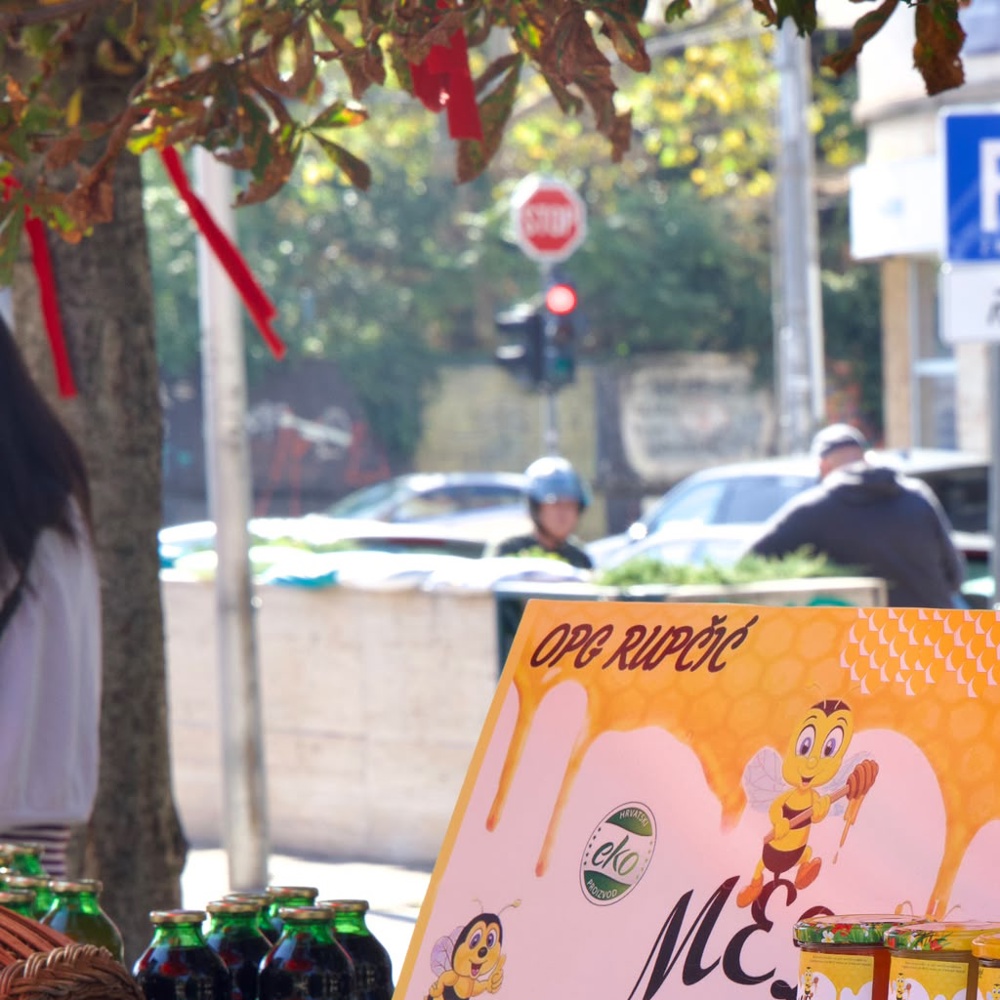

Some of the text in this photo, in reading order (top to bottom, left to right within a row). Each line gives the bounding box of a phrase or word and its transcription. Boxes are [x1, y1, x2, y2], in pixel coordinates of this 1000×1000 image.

[524, 205, 572, 237] STOP
[530, 615, 759, 673] OPG RUPČIĆ
[620, 809, 649, 827] HRVATSKI
[592, 835, 640, 876] eko
[587, 879, 618, 899] PROIZVOD
